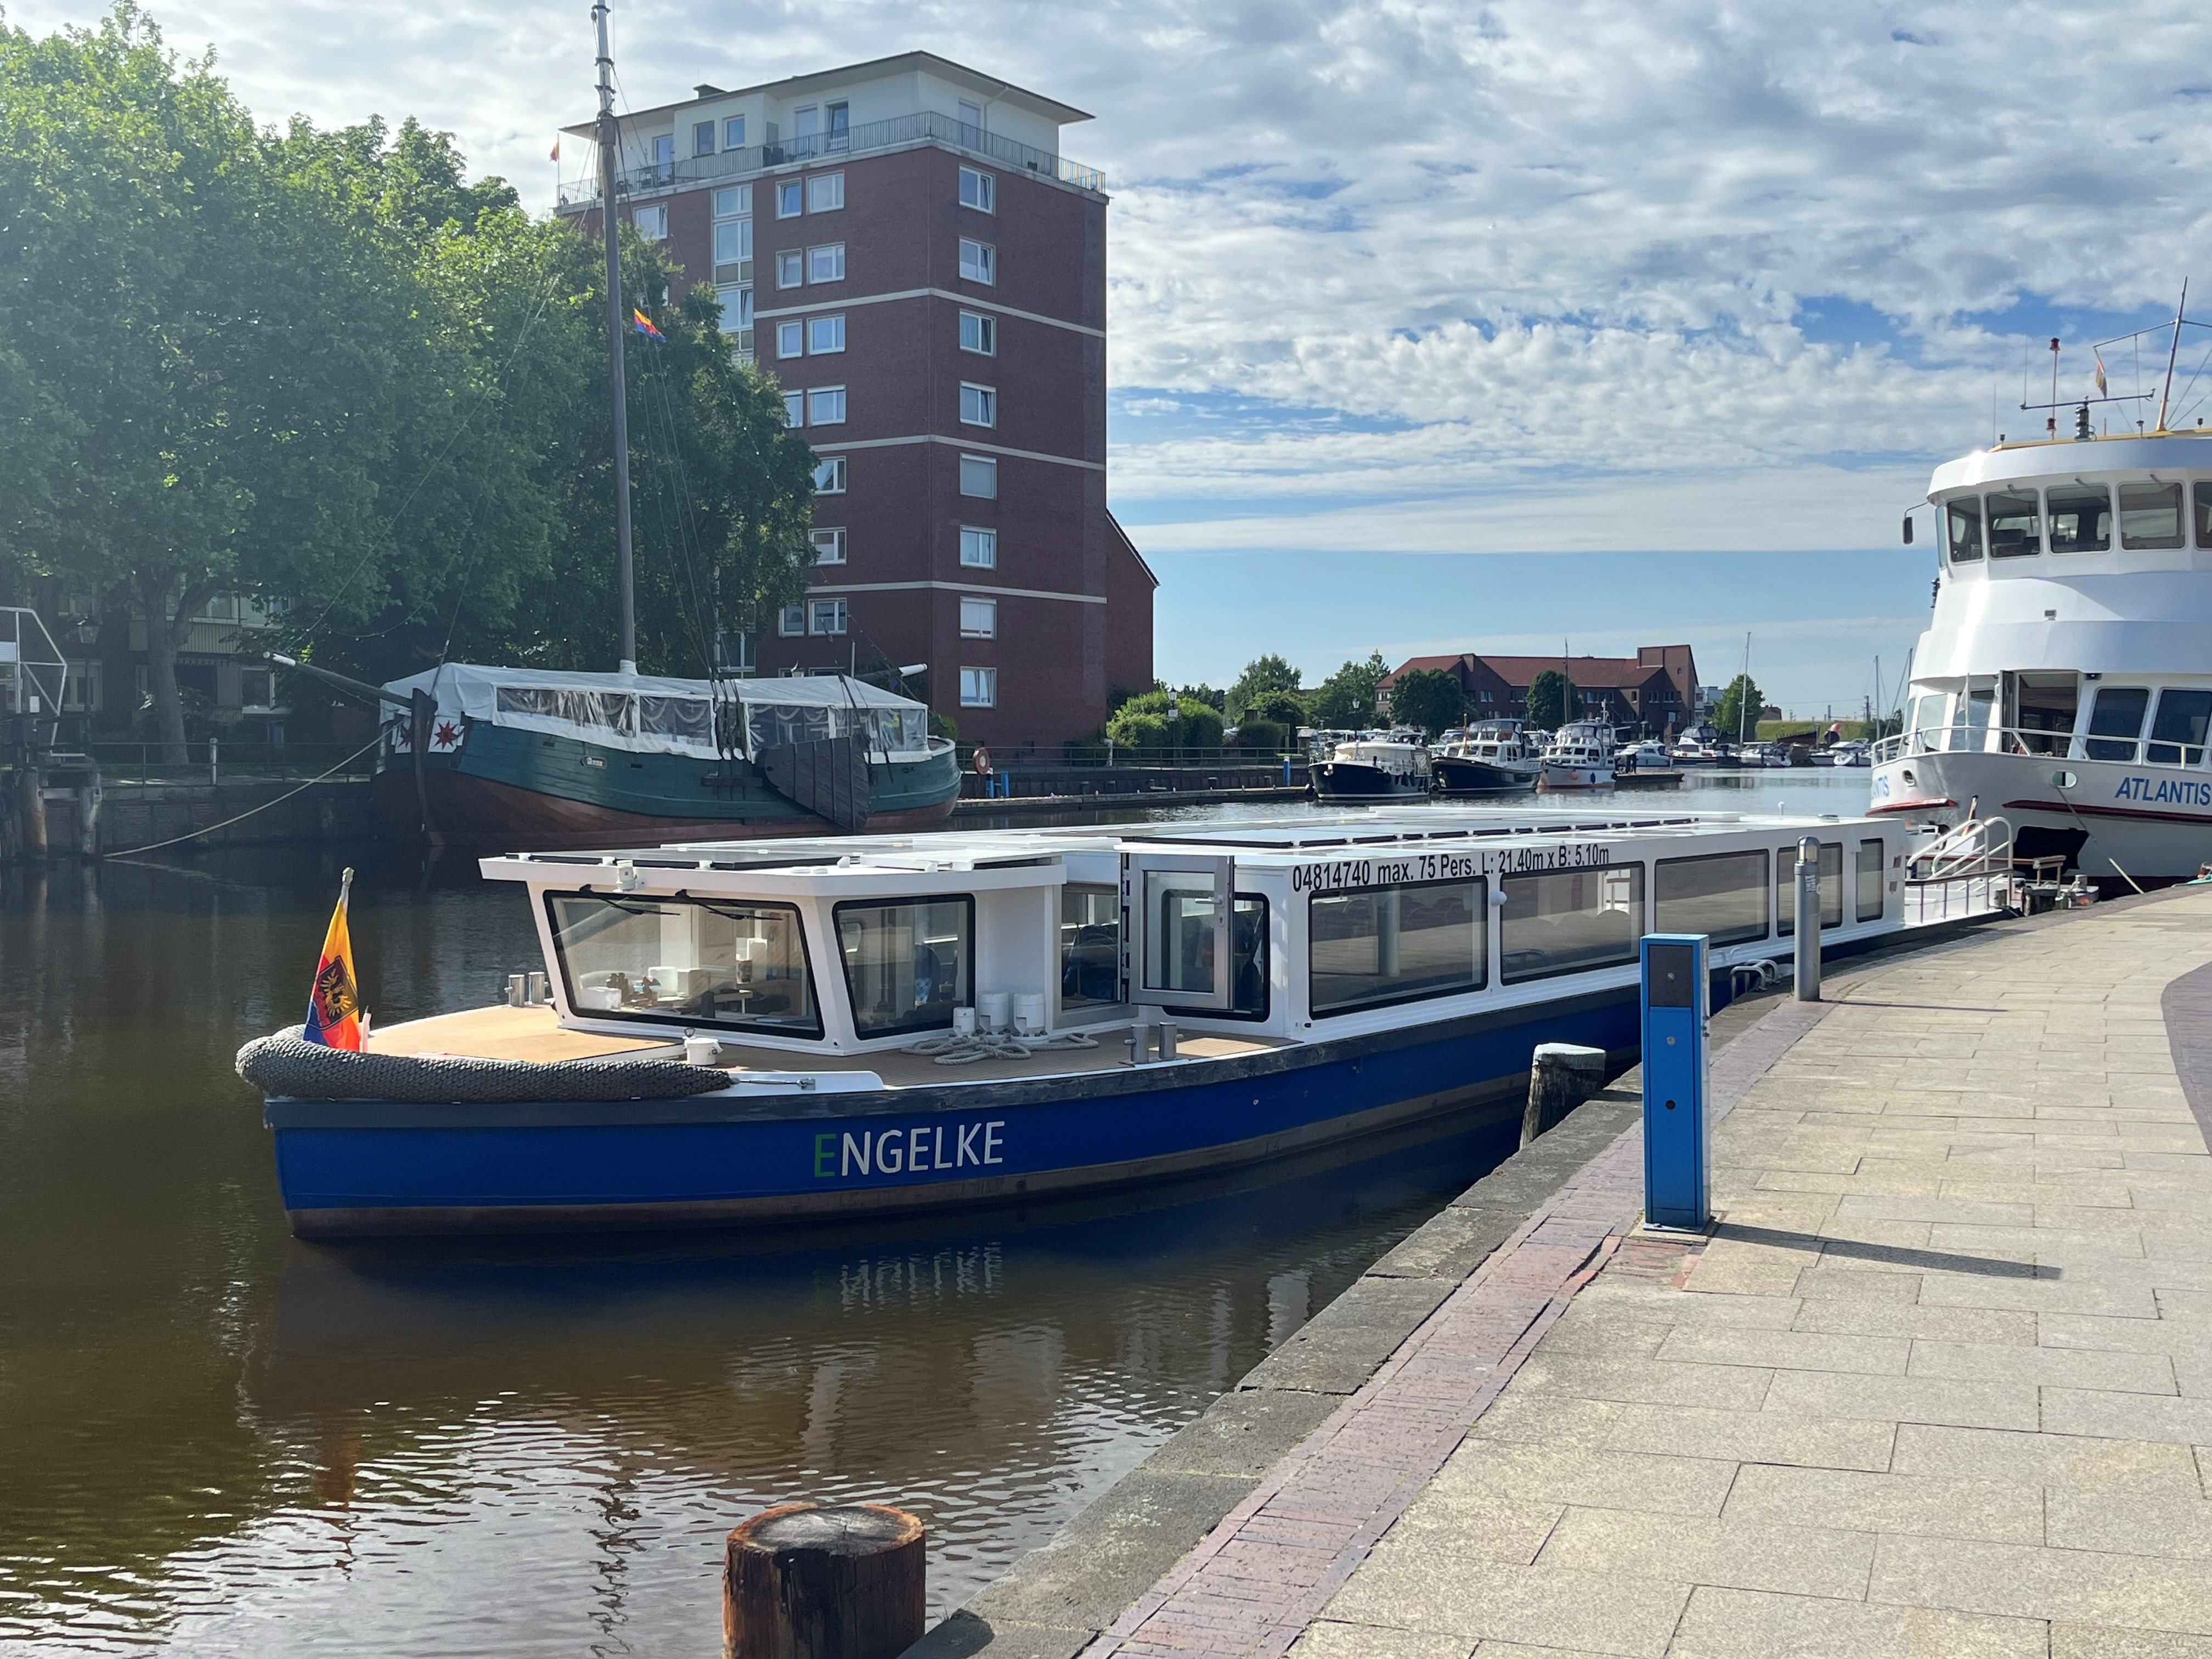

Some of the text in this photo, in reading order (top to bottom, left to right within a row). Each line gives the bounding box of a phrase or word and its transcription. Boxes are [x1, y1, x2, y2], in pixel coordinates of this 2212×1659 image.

[2115, 777, 2211, 806] ATLANTIS
[1293, 843, 1609, 892] 04814740 max. 75 Pers. L: 21.40m x B: 5.10m
[814, 1121, 1005, 1178] ENGELKE
